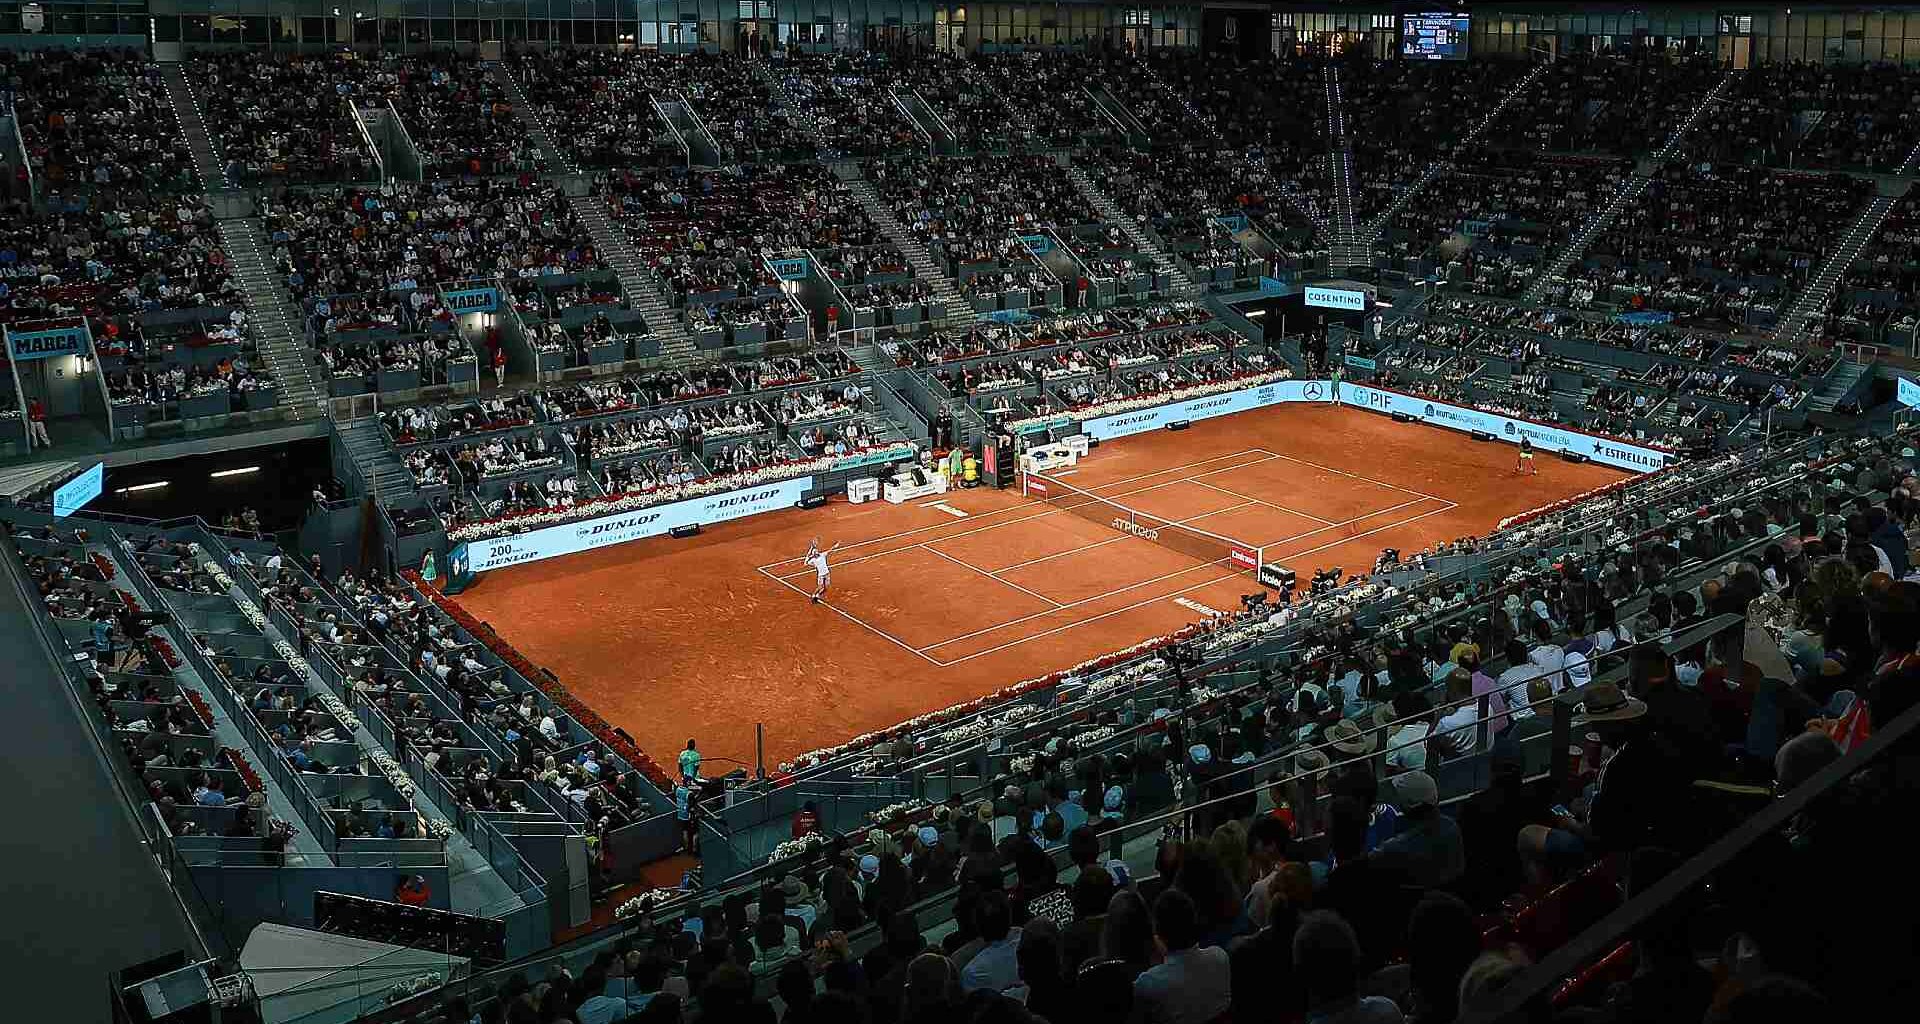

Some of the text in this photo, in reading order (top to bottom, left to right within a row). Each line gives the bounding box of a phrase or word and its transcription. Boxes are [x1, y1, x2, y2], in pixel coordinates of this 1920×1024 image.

[447, 291, 492, 309] MARCA
[1308, 292, 1361, 305] COSENTINO
[15, 335, 77, 355] MARCA
[1192, 397, 1232, 411] DUNLOP
[1370, 392, 1393, 409] PIF
[1113, 413, 1158, 427] DUNLOP
[1605, 447, 1648, 466] ESTRELLA
[718, 489, 780, 509] DUNLOP
[592, 513, 661, 534] DUNLOP
[486, 551, 539, 567] DUNLOP
[490, 544, 512, 558] 200
